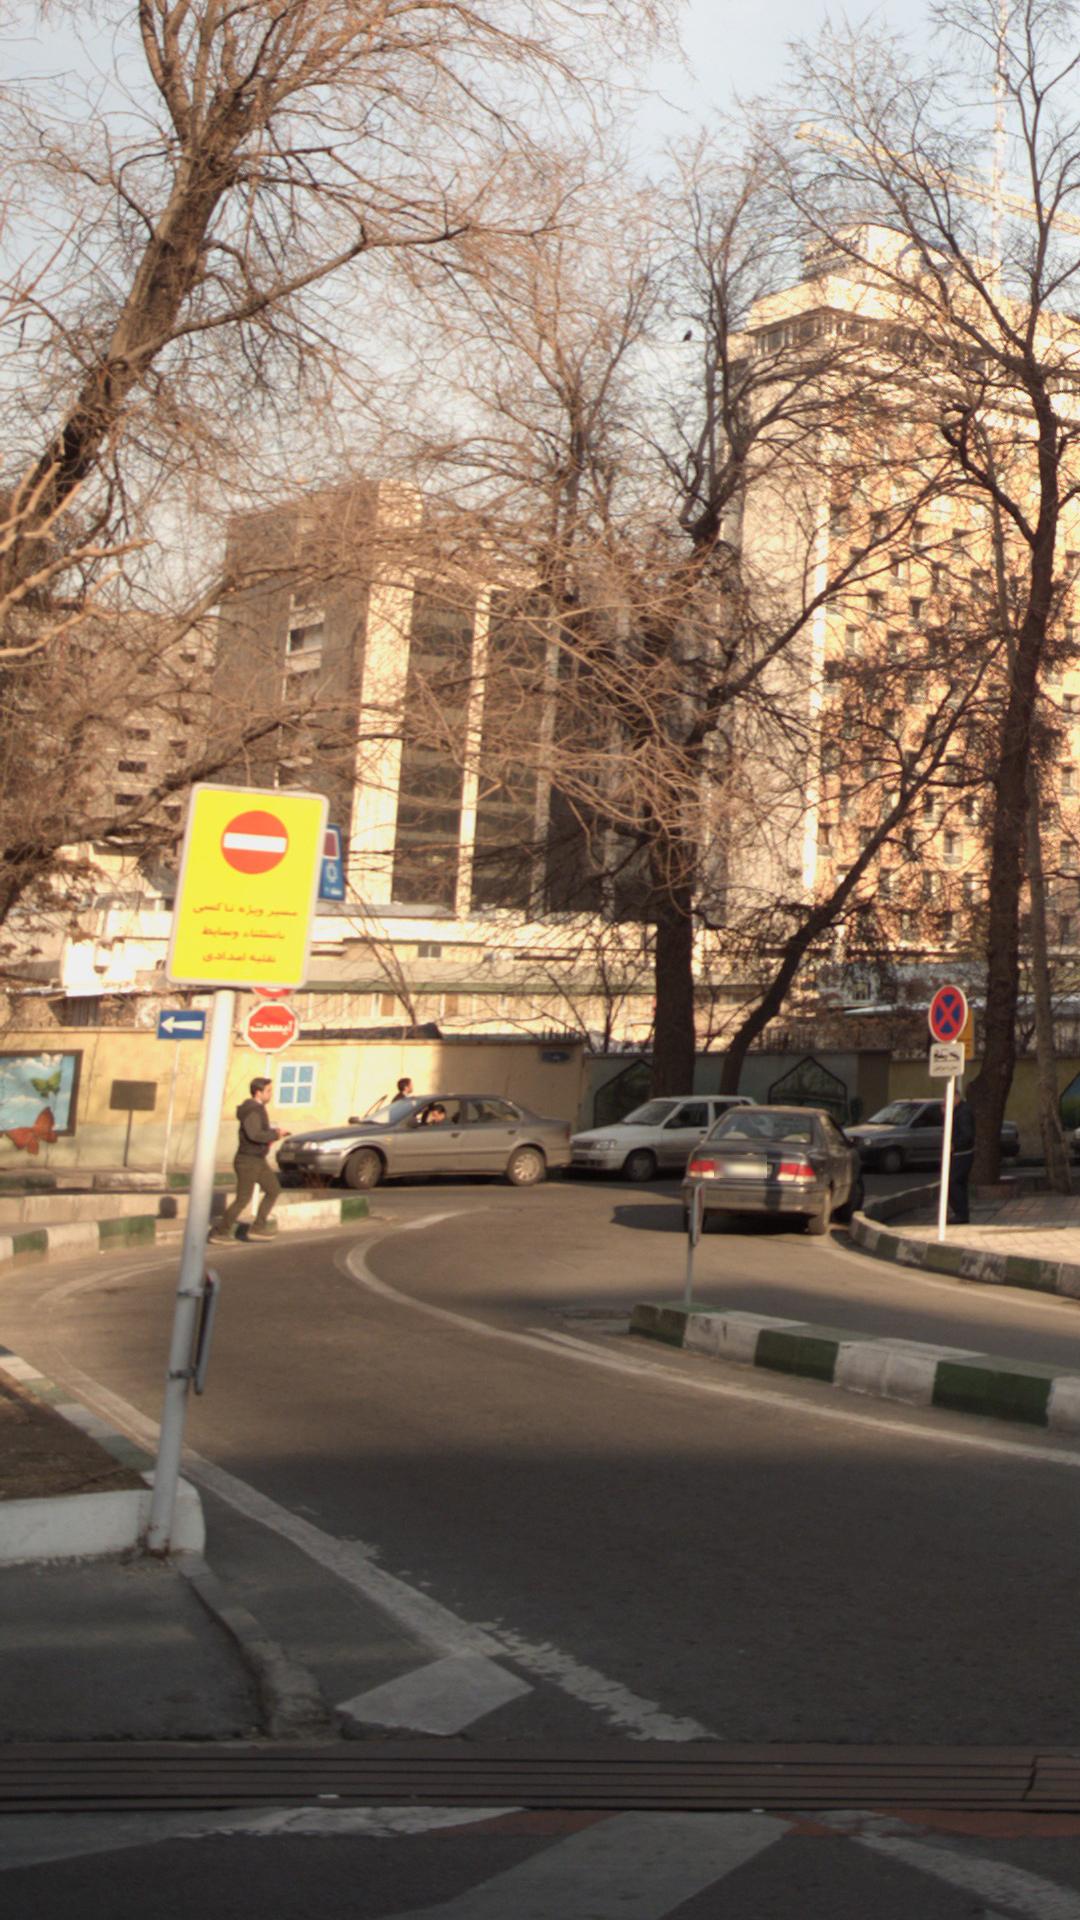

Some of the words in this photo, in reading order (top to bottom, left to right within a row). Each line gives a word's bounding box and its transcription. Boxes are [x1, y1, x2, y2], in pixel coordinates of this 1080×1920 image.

[192, 902, 234, 914] تاکسی
[238, 902, 264, 917] ویژه
[267, 907, 299, 918] مسیر
[250, 1020, 293, 1036] ایست
